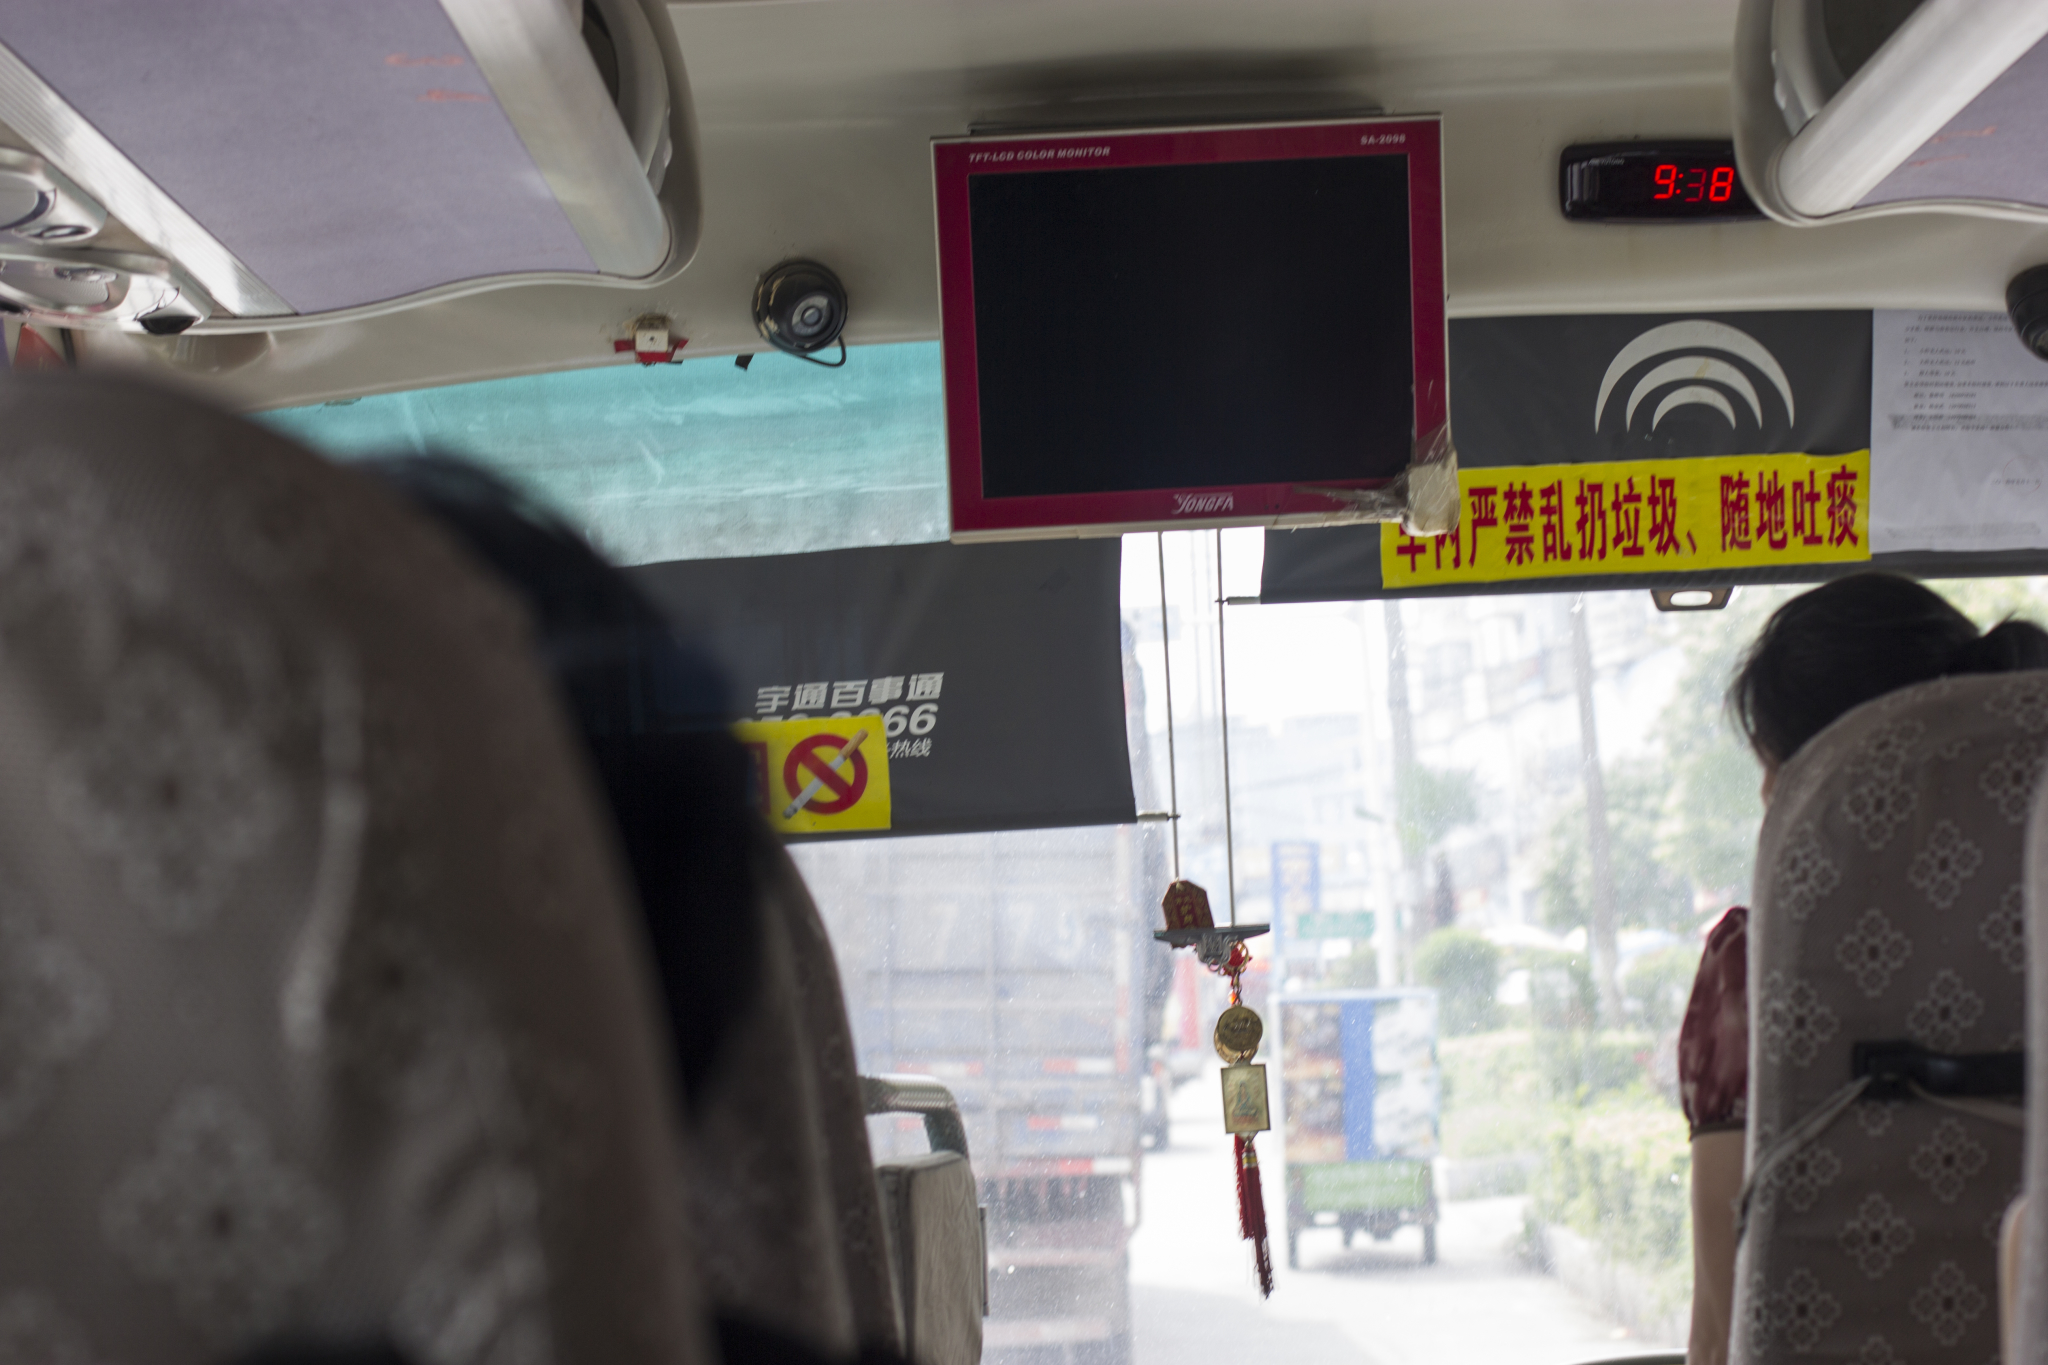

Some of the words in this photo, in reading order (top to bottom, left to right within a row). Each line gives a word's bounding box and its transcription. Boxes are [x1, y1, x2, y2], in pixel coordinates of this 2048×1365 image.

[969, 151, 1015, 163] TFT-LCD
[1016, 149, 1055, 160] COLOR
[1057, 146, 1111, 158] MONITOR
[1653, 165, 1735, 202] 9:38
